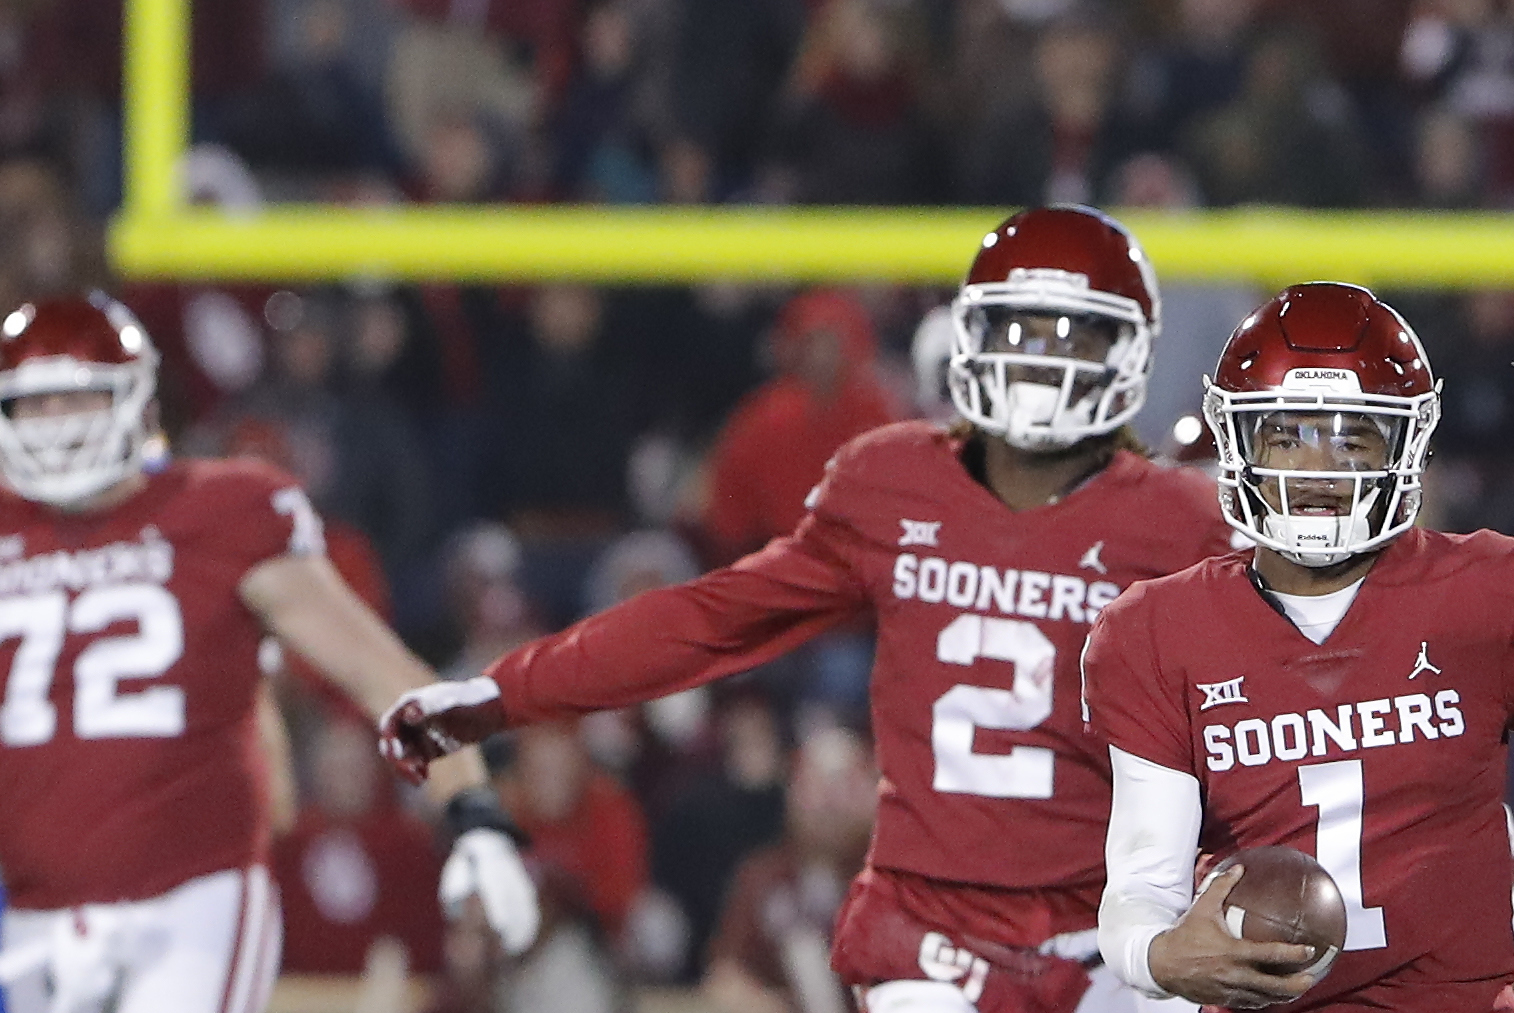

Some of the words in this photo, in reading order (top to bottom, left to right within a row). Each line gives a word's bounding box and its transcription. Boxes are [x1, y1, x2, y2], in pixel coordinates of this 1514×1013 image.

[1294, 370, 1348, 381] OKLAHOMA
[892, 553, 1121, 625] SOONERS
[0, 587, 187, 747] 72
[932, 613, 1056, 800] 2
[1203, 689, 1466, 772] SOONERS
[1298, 759, 1388, 951] 1
